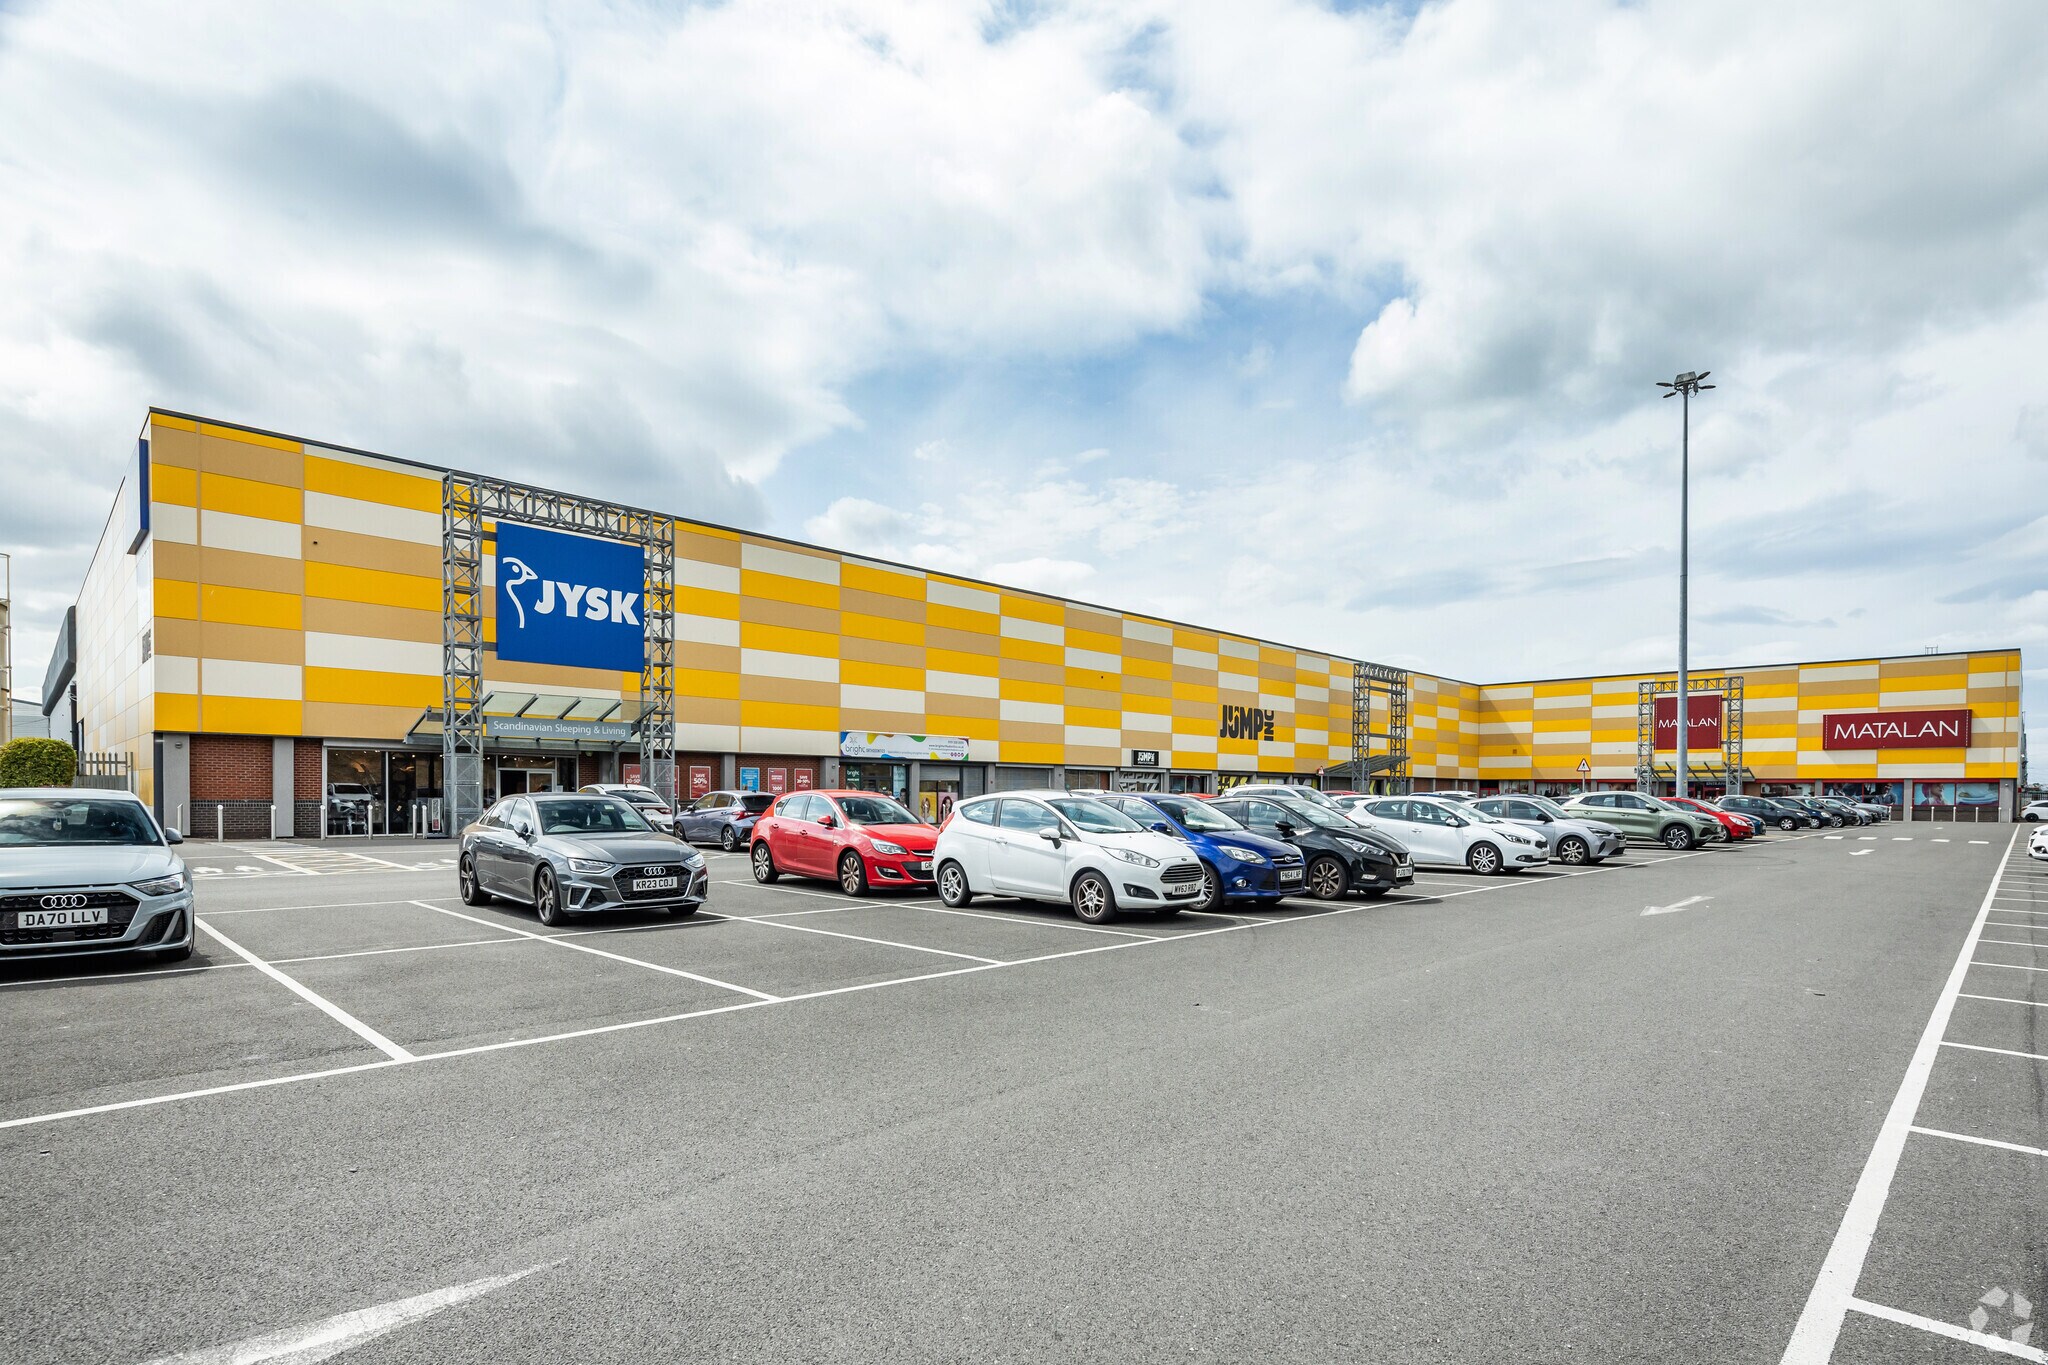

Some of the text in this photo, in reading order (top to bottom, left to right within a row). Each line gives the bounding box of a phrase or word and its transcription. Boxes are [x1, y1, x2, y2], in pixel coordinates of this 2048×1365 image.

[534, 579, 641, 627] JYSK
[493, 720, 626, 738] Scandinavian Sleeping & Living
[1219, 704, 1275, 742] JUMP INC
[1658, 717, 1718, 728] MALAN
[1834, 719, 1960, 741] MATALAN
[845, 744, 866, 756] bright
[636, 880, 657, 890] KR23
[25, 910, 101, 926] DA70 LLV
